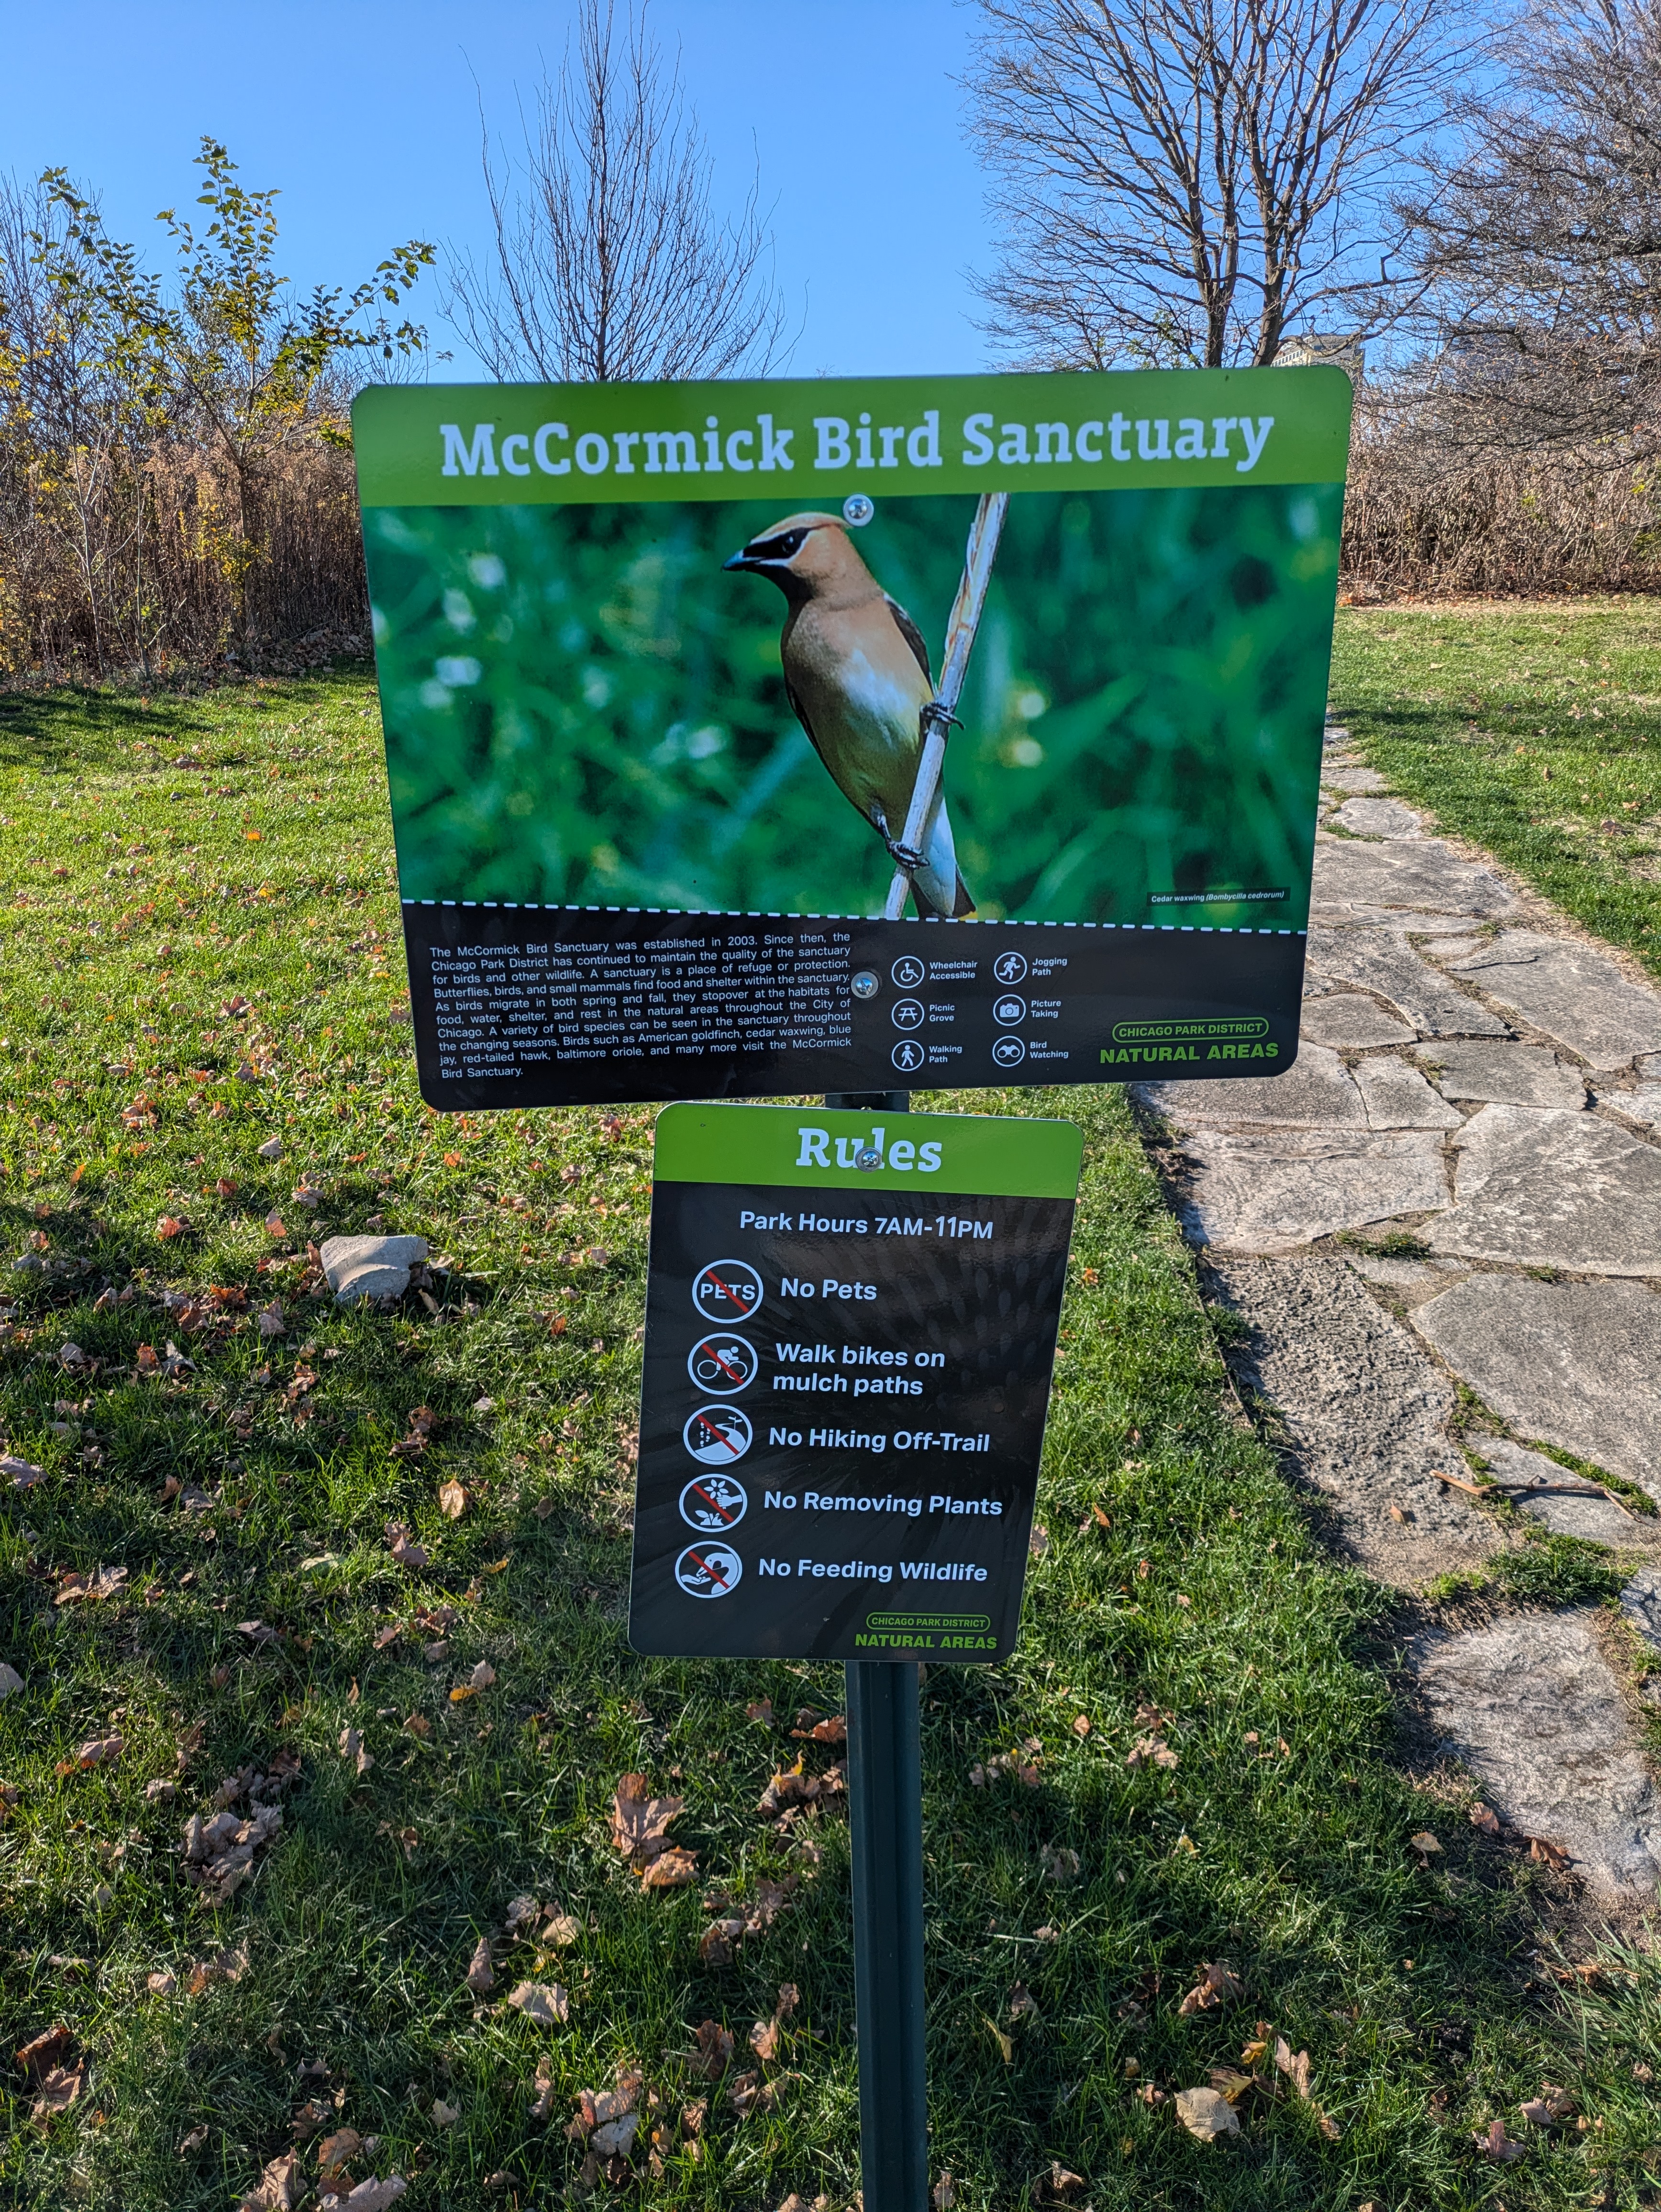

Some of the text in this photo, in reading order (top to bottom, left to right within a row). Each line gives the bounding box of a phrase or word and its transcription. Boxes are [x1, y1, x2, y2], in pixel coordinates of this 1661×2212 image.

[440, 410, 1274, 476] McCormick Bird Sanctuary
[430, 948, 451, 957] The
[458, 945, 520, 956] McCormick
[527, 943, 547, 953] Bird
[554, 943, 609, 952] Sanctuary
[644, 938, 704, 949] established
[712, 937, 720, 946] in
[728, 936, 757, 945] 2003.
[764, 935, 793, 944] Since
[800, 934, 826, 943] then,
[833, 932, 850, 941] the
[432, 947, 851, 972] Chicago Park District has continued to maintain the quality of the sanctuary
[433, 975, 448, 984] for
[454, 974, 480, 984] birds
[486, 973, 506, 982] and
[512, 972, 540, 981] other
[545, 970, 584, 980] wildlife.
[590, 969, 598, 978] A
[604, 968, 656, 978] sanctuary
[662, 966, 670, 975] is
[688, 965, 716, 976] place
[722, 963, 733, 973] of
[739, 962, 772, 973] refuge
[794, 959, 850, 972] protection.
[930, 961, 977, 969] Wheelchair
[1032, 958, 1067, 966] Jogging
[434, 973, 850, 997] Butterflies, birds, and small mammals find food and shelter within the sanctuary.
[930, 971, 975, 980] Accessible
[436, 986, 850, 1011] As birds migrate in both spring and fall, they stopover at the habitats for
[436, 1015, 464, 1025] food,
[470, 1014, 501, 1023] water,
[509, 1012, 547, 1021] shelter,
[554, 1010, 574, 1019] and
[581, 1009, 601, 1018] rest
[608, 1008, 617, 1017] in
[624, 1008, 641, 1017] the
[648, 1006, 683, 1016] natural
[725, 1002, 783, 1013] throughout
[789, 1001, 806, 1009] the
[813, 999, 833, 1010] City
[841, 998, 851, 1007] of
[1031, 1010, 1058, 1018] Taking
[438, 1029, 484, 1039] Chicago.
[489, 1027, 497, 1035] A
[502, 1026, 538, 1036] variety
[543, 1024, 554, 1033] of
[559, 1023, 578, 1032] bird
[584, 1022, 625, 1033] species
[654, 1020, 666, 1028] be
[702, 1018, 710, 1026] in
[716, 1017, 732, 1026] the
[738, 1016, 789, 1025] sanctuary
[794, 1012, 851, 1023] throughout
[1119, 1023, 1262, 1037] CHICAGO PARK DISTRICT
[439, 1042, 456, 1051] the
[460, 1040, 509, 1051] changing
[513, 1040, 559, 1048] seasons.
[564, 1036, 589, 1045] Birds
[594, 1035, 619, 1044] such
[639, 1032, 687, 1042] American
[692, 1029, 742, 1042] goldfinch,
[746, 1028, 775, 1037] cedar
[779, 1026, 825, 1036] waxwing,
[830, 1025, 851, 1034] blue
[1100, 1043, 1278, 1063] NATURAL AREAS
[796, 1128, 942, 1172] Rules
[741, 1211, 993, 1239] Park Hours 7AM-11PM
[701, 1283, 755, 1300] PETS
[781, 1278, 877, 1300] No Pets
[776, 1343, 944, 1367] Walk bikes on
[774, 1373, 923, 1396] mulch paths
[770, 1427, 989, 1452] No Hiking Off-Trail
[764, 1491, 1002, 1516] No Removing Plants
[759, 1559, 987, 1582] No Feeding Wildlife
[872, 1617, 914, 1626] CHICAGO
[855, 1634, 997, 1649] NATURAL AREAS
